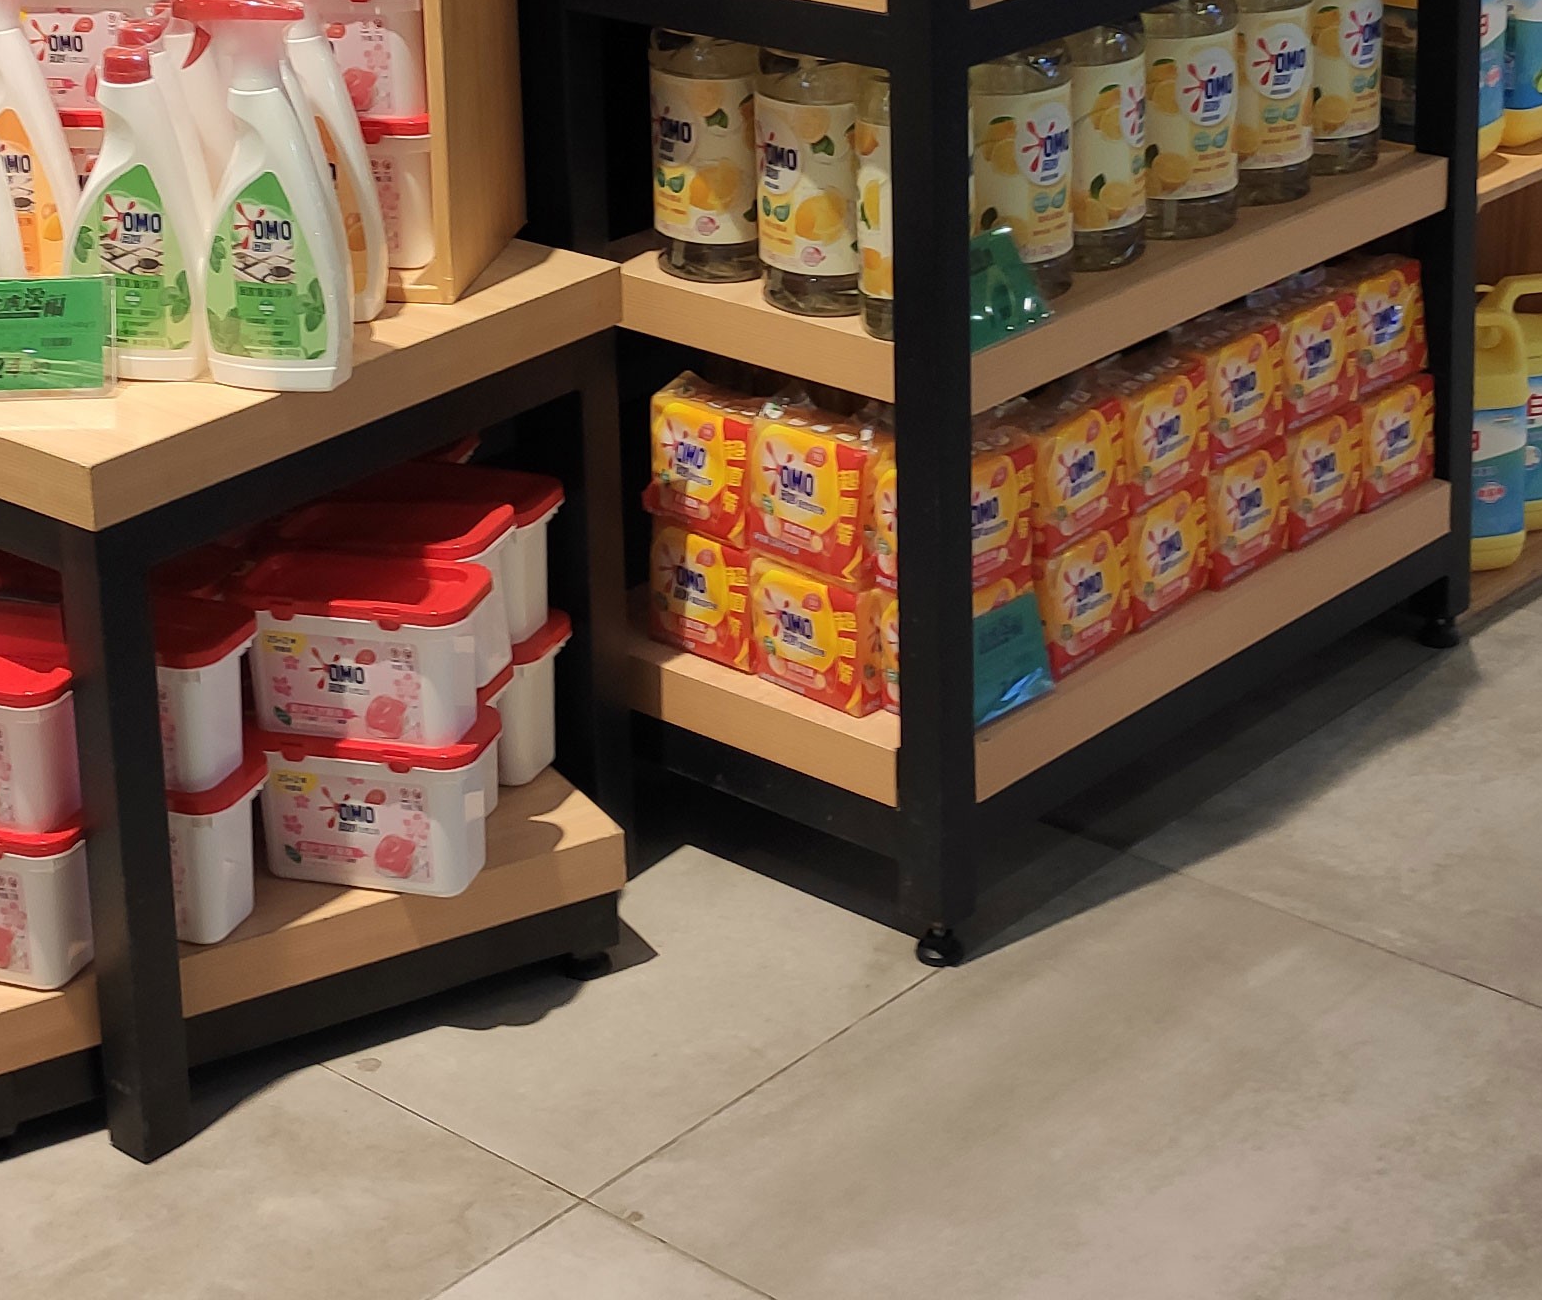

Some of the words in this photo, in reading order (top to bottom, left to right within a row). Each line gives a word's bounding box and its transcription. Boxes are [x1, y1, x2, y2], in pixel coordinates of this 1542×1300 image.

[48, 33, 84, 55] OMO
[1274, 47, 1307, 74] OMO
[1204, 72, 1233, 100] OMO
[659, 115, 692, 145] OMO
[2, 153, 32, 175] MO
[764, 141, 797, 172] OMO
[123, 211, 162, 235] OMO
[252, 218, 293, 242] OMO
[674, 440, 707, 470] OMO
[780, 463, 815, 497] OMO
[676, 564, 707, 595] OMO
[780, 609, 814, 640] OMO
[328, 662, 366, 685] OMO
[338, 803, 375, 825] OMO
